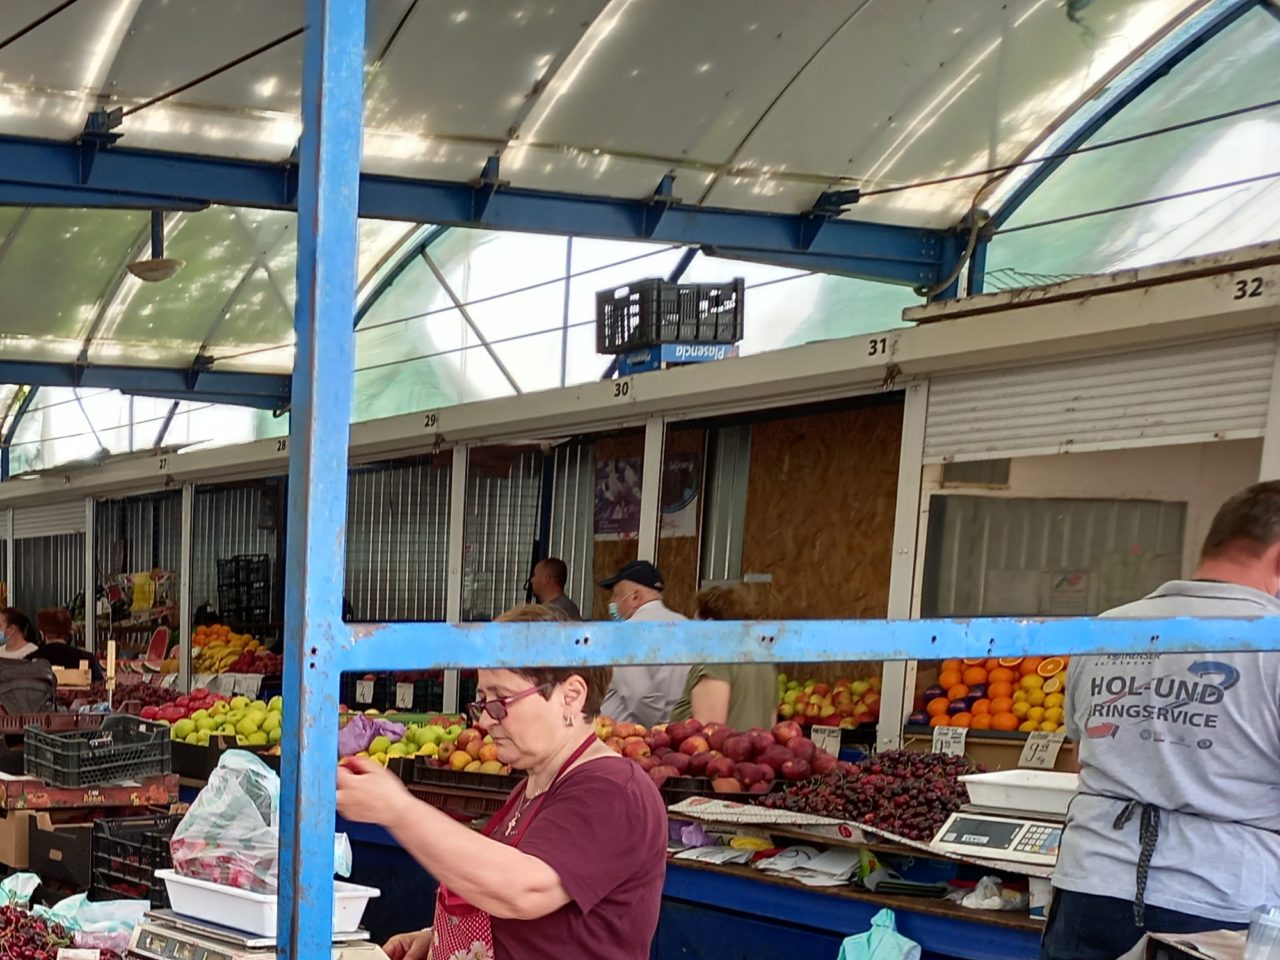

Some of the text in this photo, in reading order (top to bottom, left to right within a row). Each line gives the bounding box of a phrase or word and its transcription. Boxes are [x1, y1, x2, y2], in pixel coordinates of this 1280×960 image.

[1234, 277, 1263, 300] 32
[675, 344, 726, 361] Plasencia
[868, 338, 887, 356] 31
[613, 381, 629, 398] 30
[424, 414, 436, 427] 29
[276, 440, 286, 452] 28
[159, 458, 168, 470] 27
[1088, 703, 1219, 729] RINGSERVICE
